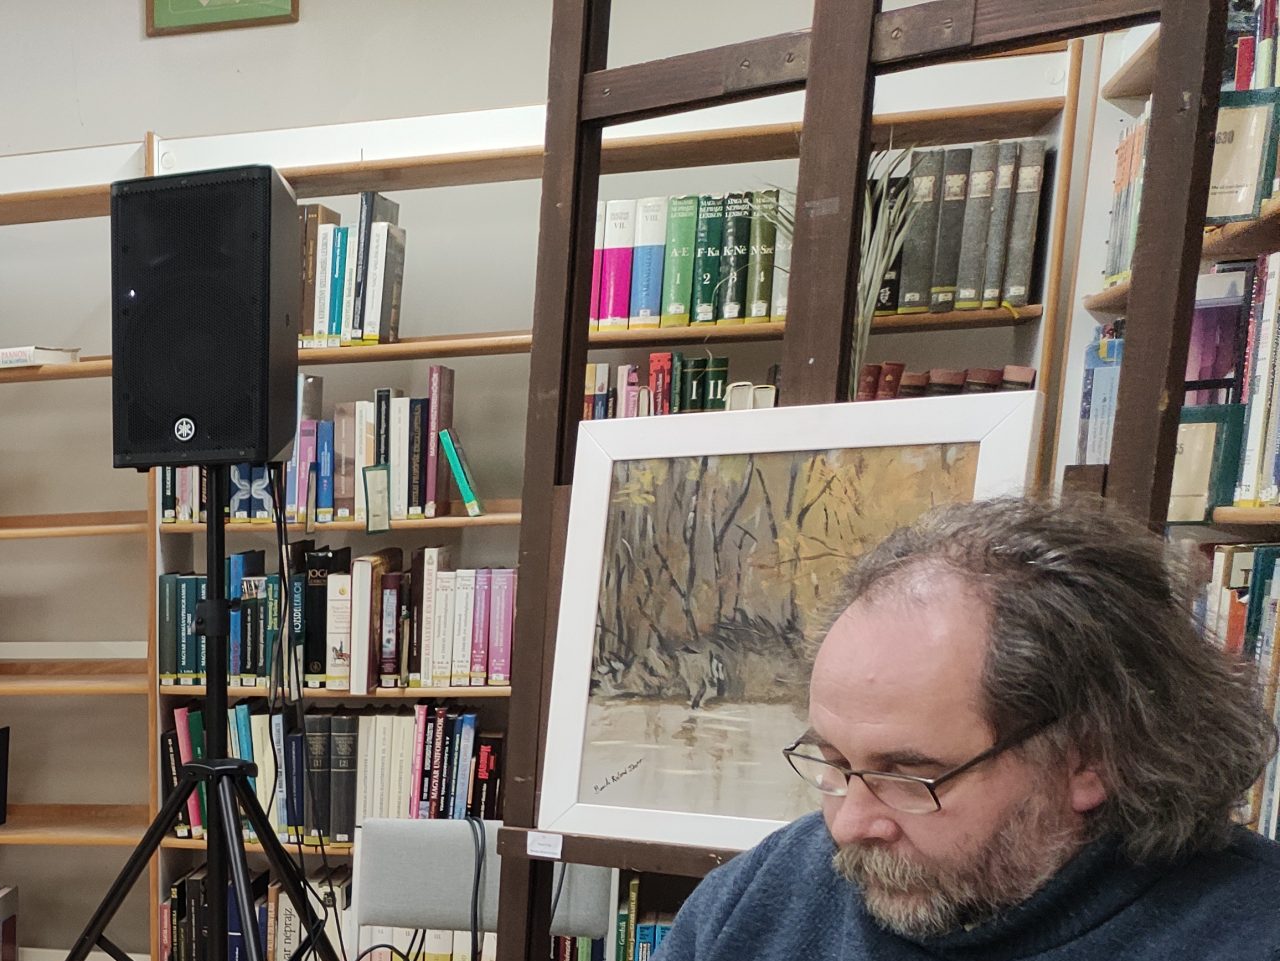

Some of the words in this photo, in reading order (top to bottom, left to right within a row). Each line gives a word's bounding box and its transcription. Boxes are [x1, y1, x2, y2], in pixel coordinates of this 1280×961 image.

[703, 272, 710, 285] 2
[709, 380, 722, 399] II
[307, 568, 328, 578] JOGI
[434, 717, 444, 769] UNIFORMISOK
[431, 769, 440, 800] MAGYAR
[279, 907, 297, 945] néprajz
